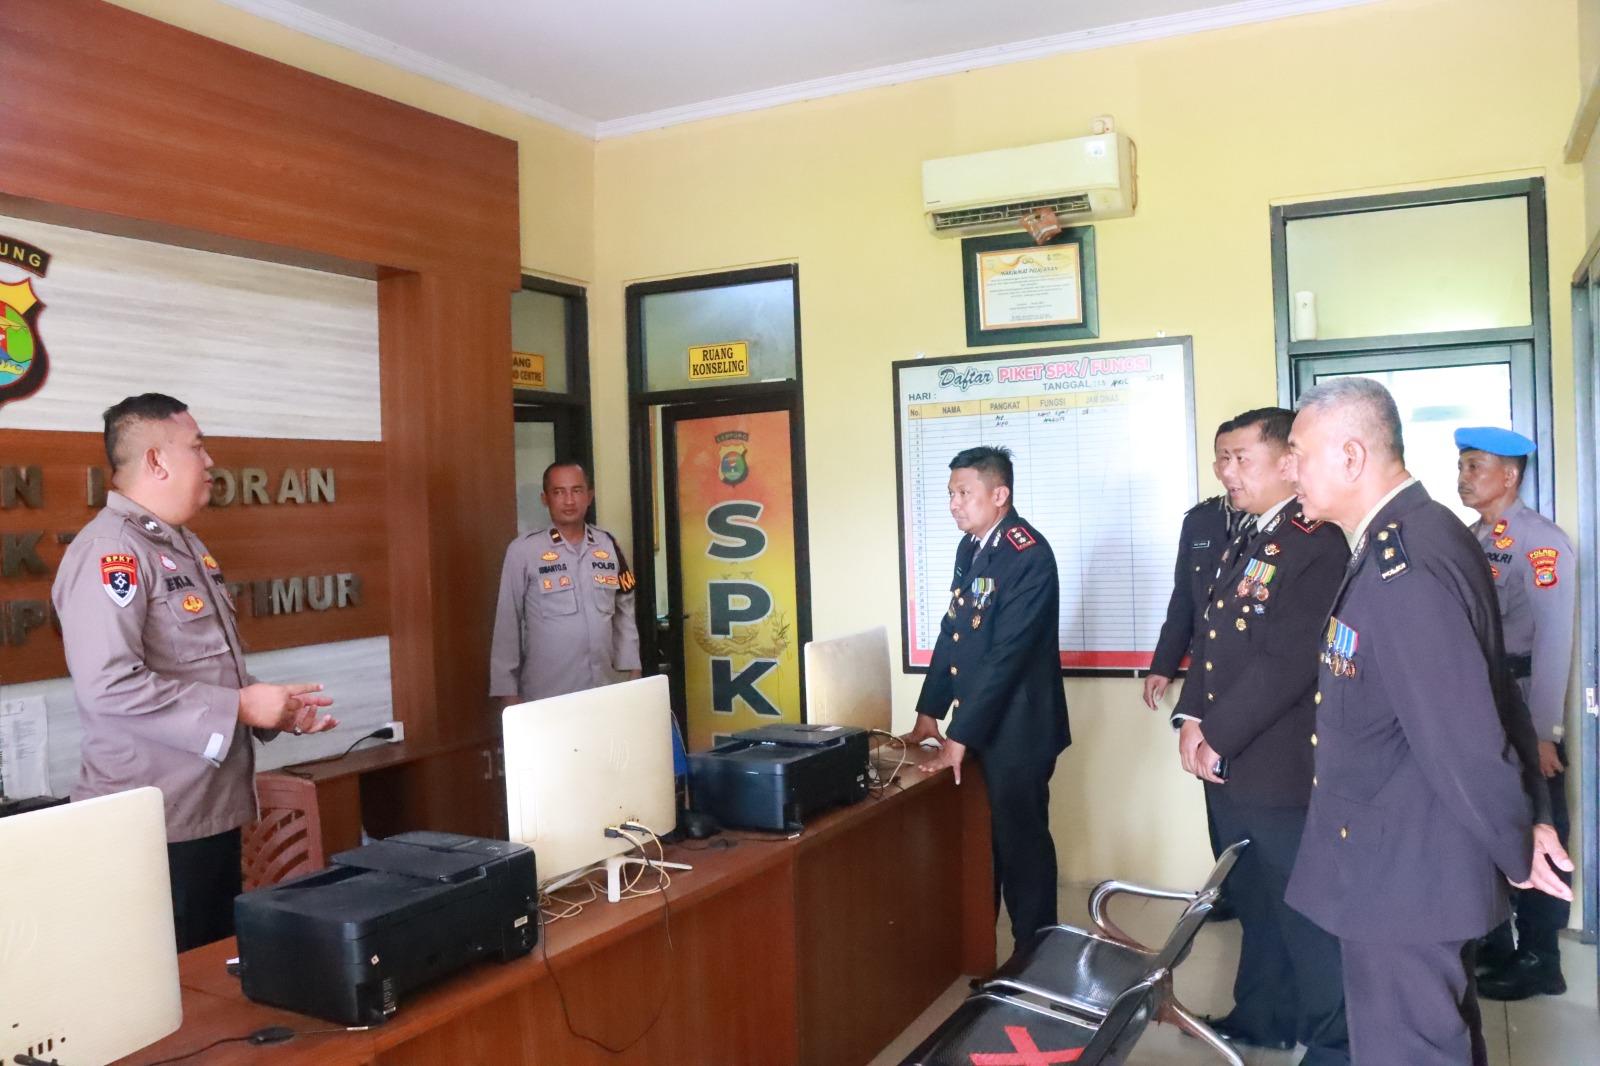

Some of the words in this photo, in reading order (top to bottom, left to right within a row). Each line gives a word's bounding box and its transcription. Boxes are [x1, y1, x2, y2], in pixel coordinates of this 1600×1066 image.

[702, 347, 733, 361] RUANG
[513, 356, 531, 368] ANG
[692, 360, 745, 376] KONSELING
[938, 367, 992, 391] Daftar
[998, 363, 1043, 384] PIKET
[1042, 379, 1090, 392] TANGGAL
[908, 392, 931, 401] HARI
[942, 405, 961, 414] NAMA
[990, 401, 1021, 411] PANGKAT
[1039, 398, 1066, 407] FUNGSI
[592, 562, 616, 570] POLRI
[706, 500, 783, 745] SPK
